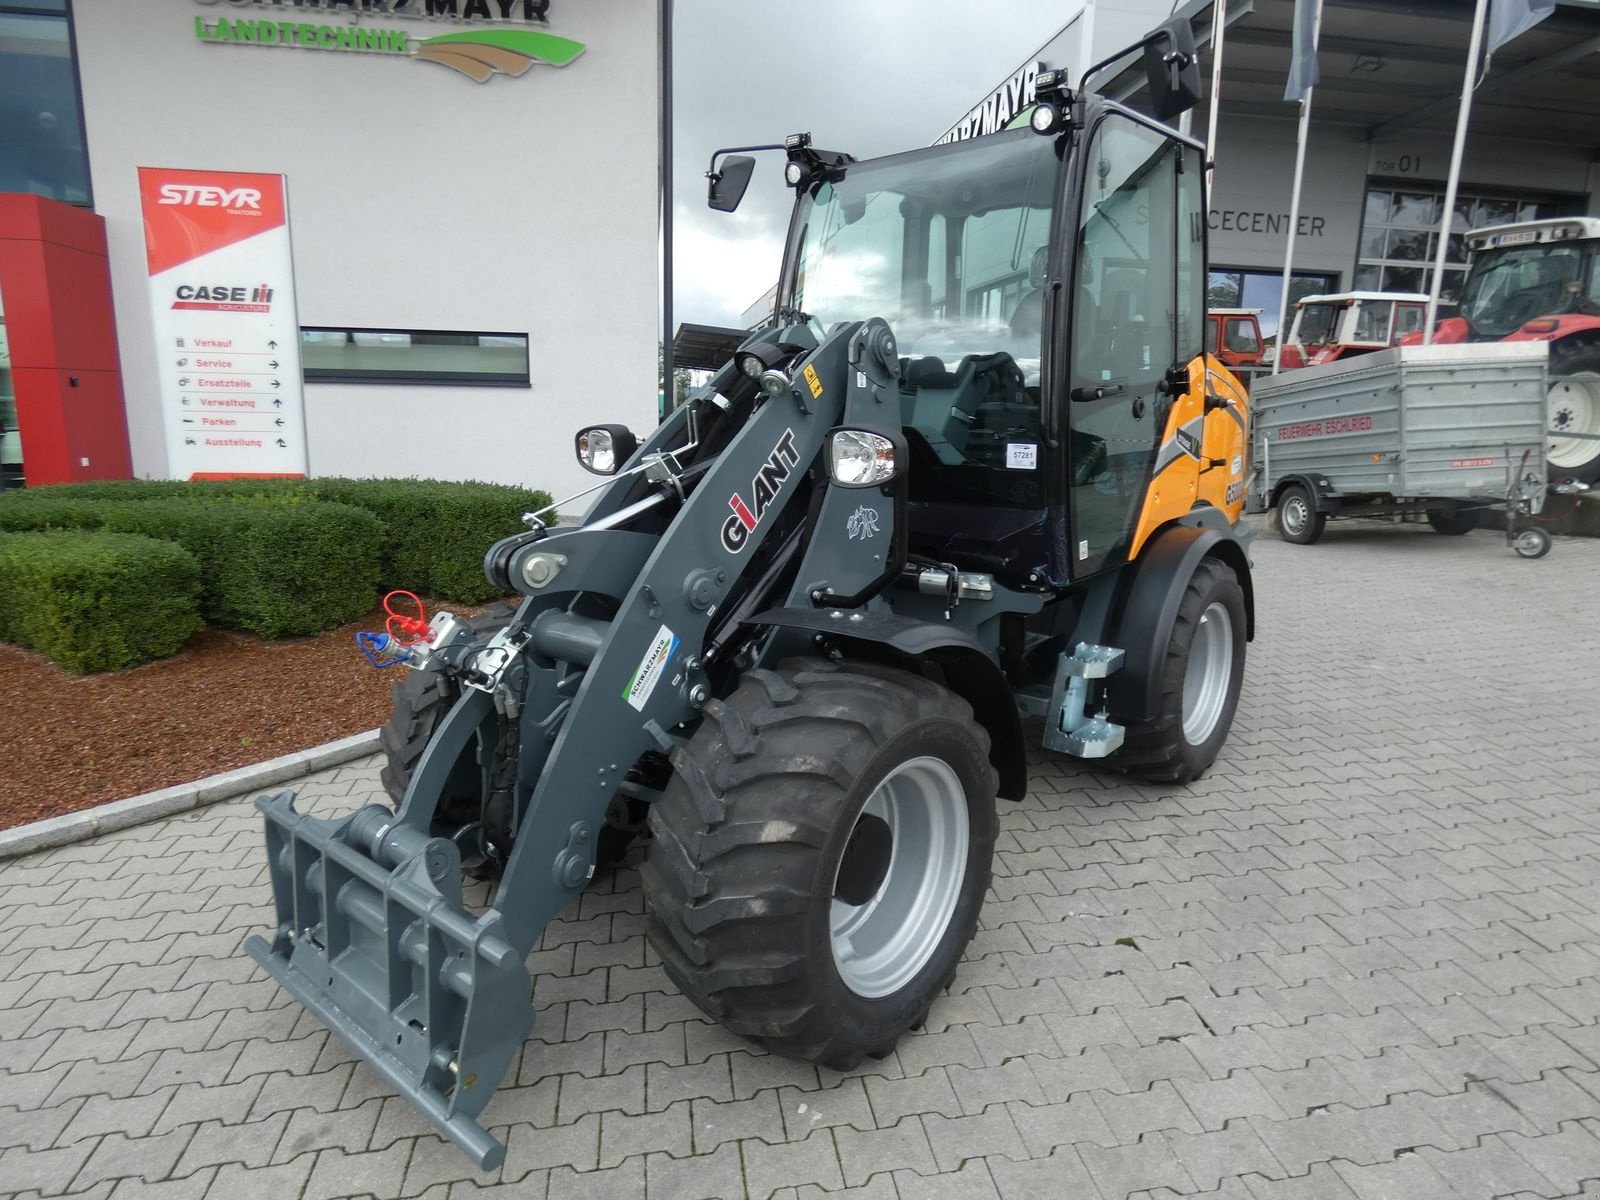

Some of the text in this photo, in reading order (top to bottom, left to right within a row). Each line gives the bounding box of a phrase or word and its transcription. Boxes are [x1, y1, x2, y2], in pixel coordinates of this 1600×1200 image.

[194, 15, 408, 52] LANDTECHNIK
[1399, 155, 1420, 174] 01
[157, 184, 262, 209] STEYR
[176, 285, 247, 302] CASE
[194, 339, 232, 348] Verkauf
[196, 360, 232, 368] Service
[198, 379, 252, 388] Ersatzteile
[200, 399, 256, 408] Verwaltung
[202, 418, 237, 426] Parken
[1279, 422, 1322, 440] FEUERWEHR
[205, 439, 263, 447] Ausstellung
[1013, 451, 1033, 459] 57281
[631, 639, 665, 697] SCHWARZMAYR
